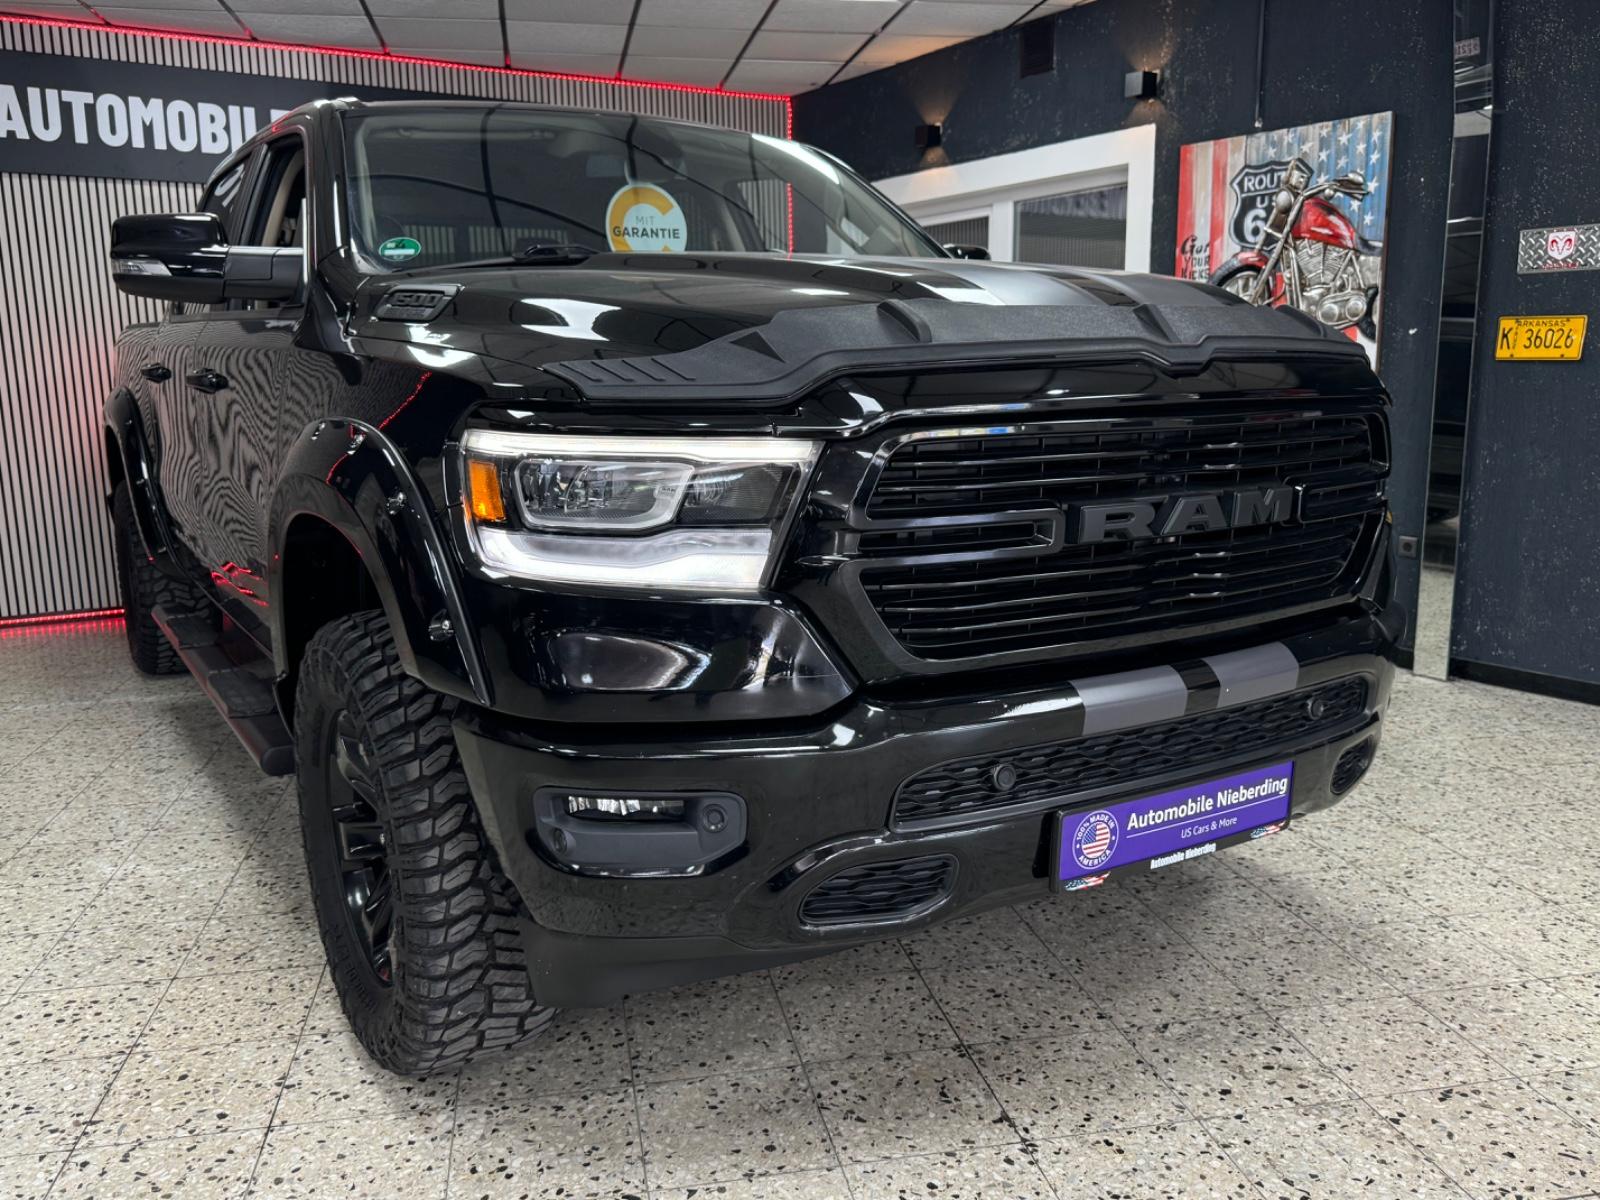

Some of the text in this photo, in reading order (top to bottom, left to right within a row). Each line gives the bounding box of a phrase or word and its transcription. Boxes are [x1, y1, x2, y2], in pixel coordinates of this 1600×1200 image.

[0, 84, 291, 155] AUTOMOBIL
[613, 226, 681, 239] GARANTIE
[635, 216, 655, 226] MIT
[1243, 208, 1267, 243] 6
[1516, 319, 1566, 328] ARKANSAS
[1500, 327, 1513, 350] K
[1523, 328, 1575, 349] 36026
[1079, 487, 1293, 545] RAM
[1127, 777, 1288, 831] Automobile Nieberding
[1089, 813, 1110, 824] MADE
[1181, 815, 1238, 839] US Cars & More
[1078, 849, 1111, 867] AMERICA
[1150, 842, 1217, 870] Automobile Nieberding
